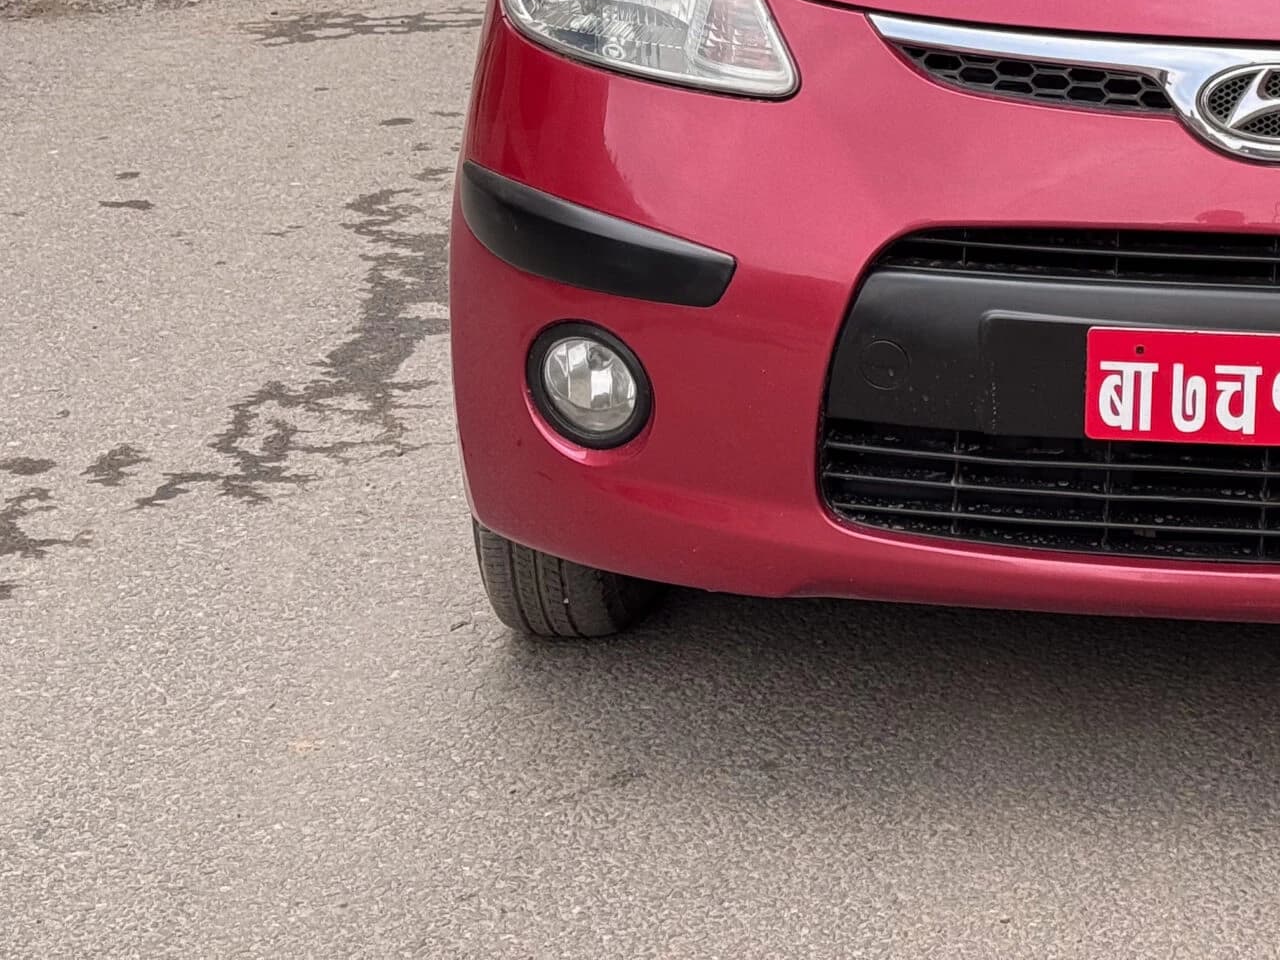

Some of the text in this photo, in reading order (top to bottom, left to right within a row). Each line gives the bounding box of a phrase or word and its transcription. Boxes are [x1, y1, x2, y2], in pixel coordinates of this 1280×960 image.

[1099, 361, 1159, 431] बा
[1171, 363, 1207, 433] ७
[1214, 364, 1263, 435] च
